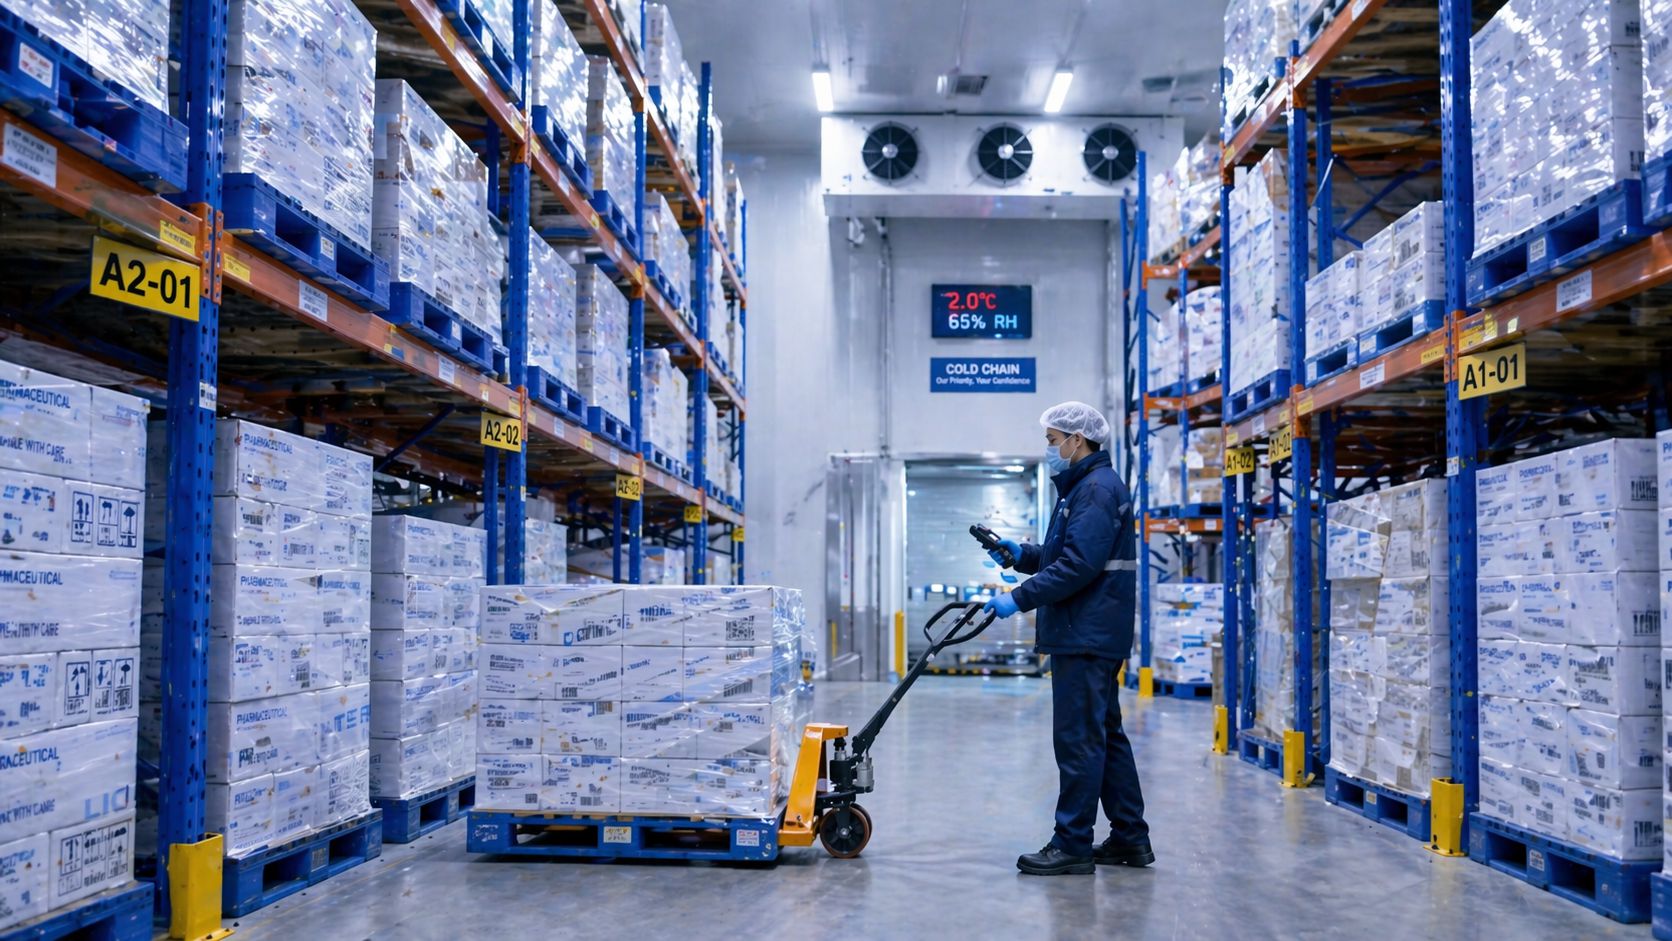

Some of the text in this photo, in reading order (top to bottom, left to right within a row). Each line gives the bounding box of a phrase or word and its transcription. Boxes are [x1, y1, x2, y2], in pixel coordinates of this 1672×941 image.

[99, 251, 191, 309] A2-01
[948, 313, 1018, 329] 65% RH
[946, 363, 1020, 375] COLD CHAIN
[1463, 353, 1518, 392] A1-01
[976, 376, 991, 385] Your
[992, 376, 1031, 385] Confidence
[484, 419, 520, 446] A2-02
[25, 439, 45, 455] WITH
[1226, 451, 1252, 470] A1-02
